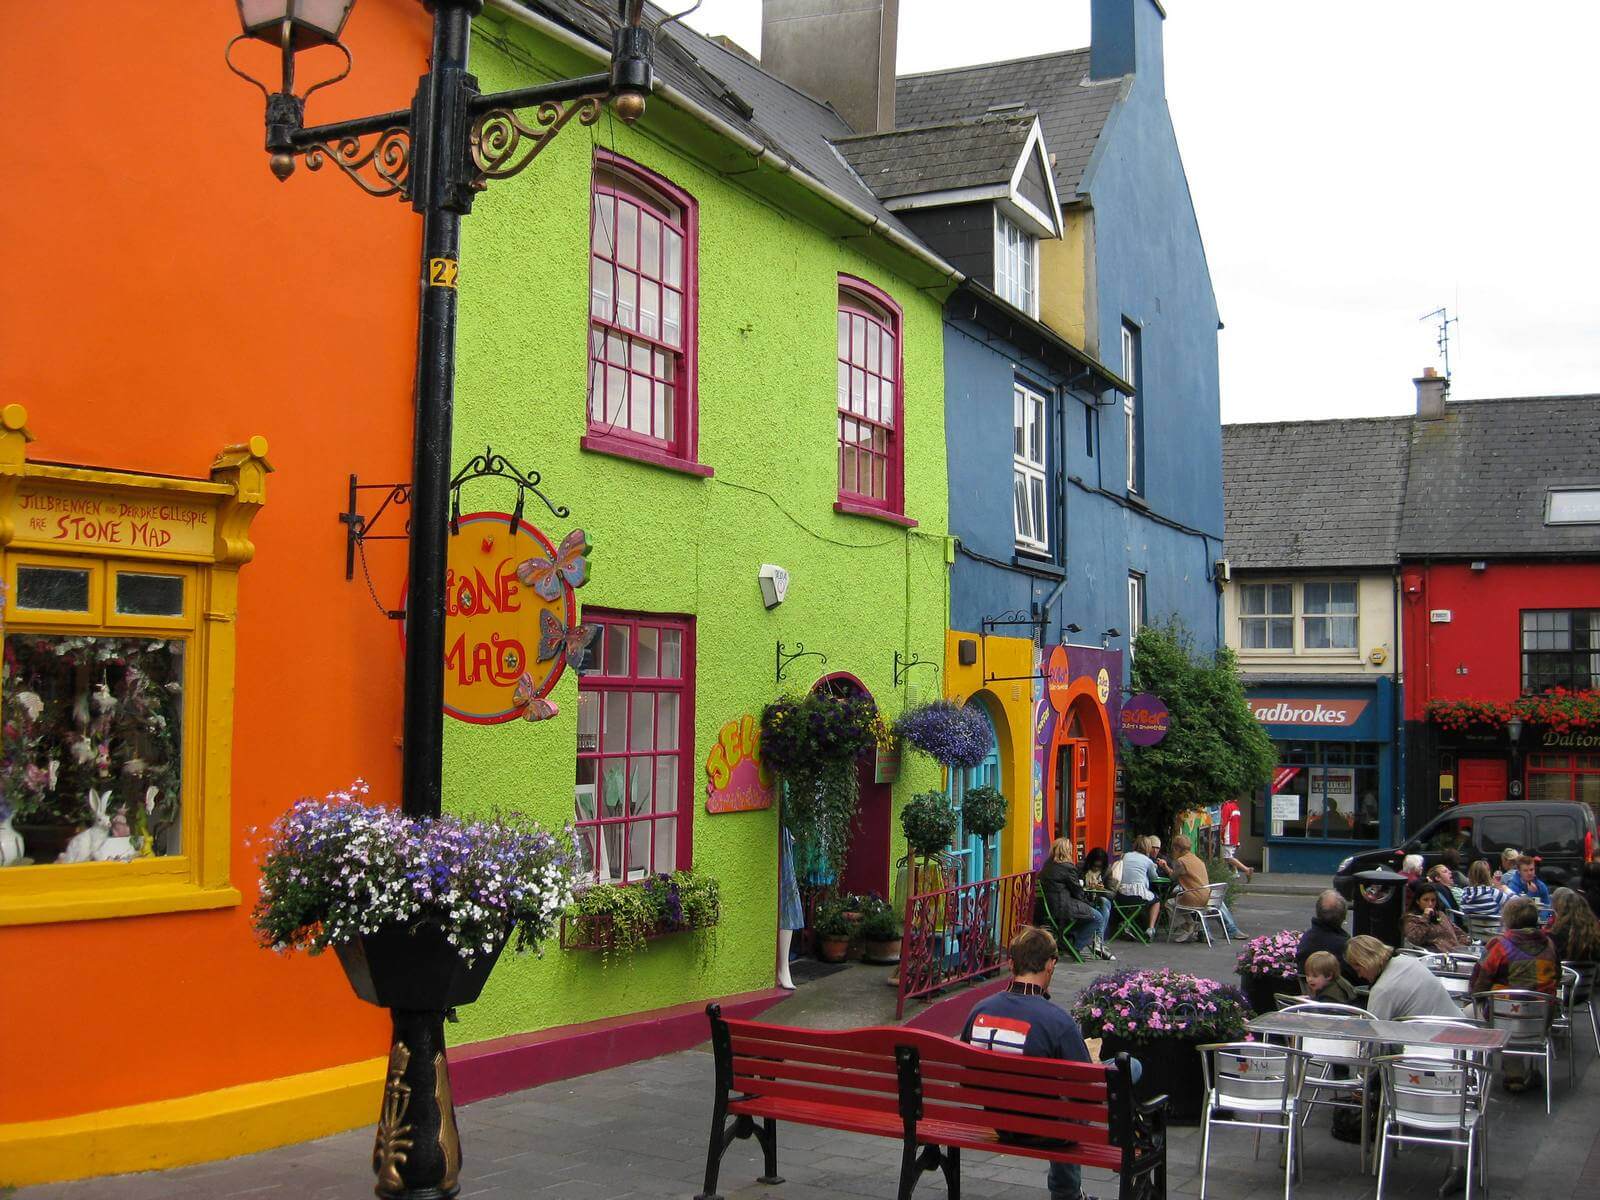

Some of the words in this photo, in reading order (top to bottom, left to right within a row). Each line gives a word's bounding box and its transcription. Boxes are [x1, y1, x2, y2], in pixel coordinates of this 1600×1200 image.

[53, 514, 123, 543] STONE
[130, 521, 172, 548] MAD
[444, 632, 526, 687] MAD
